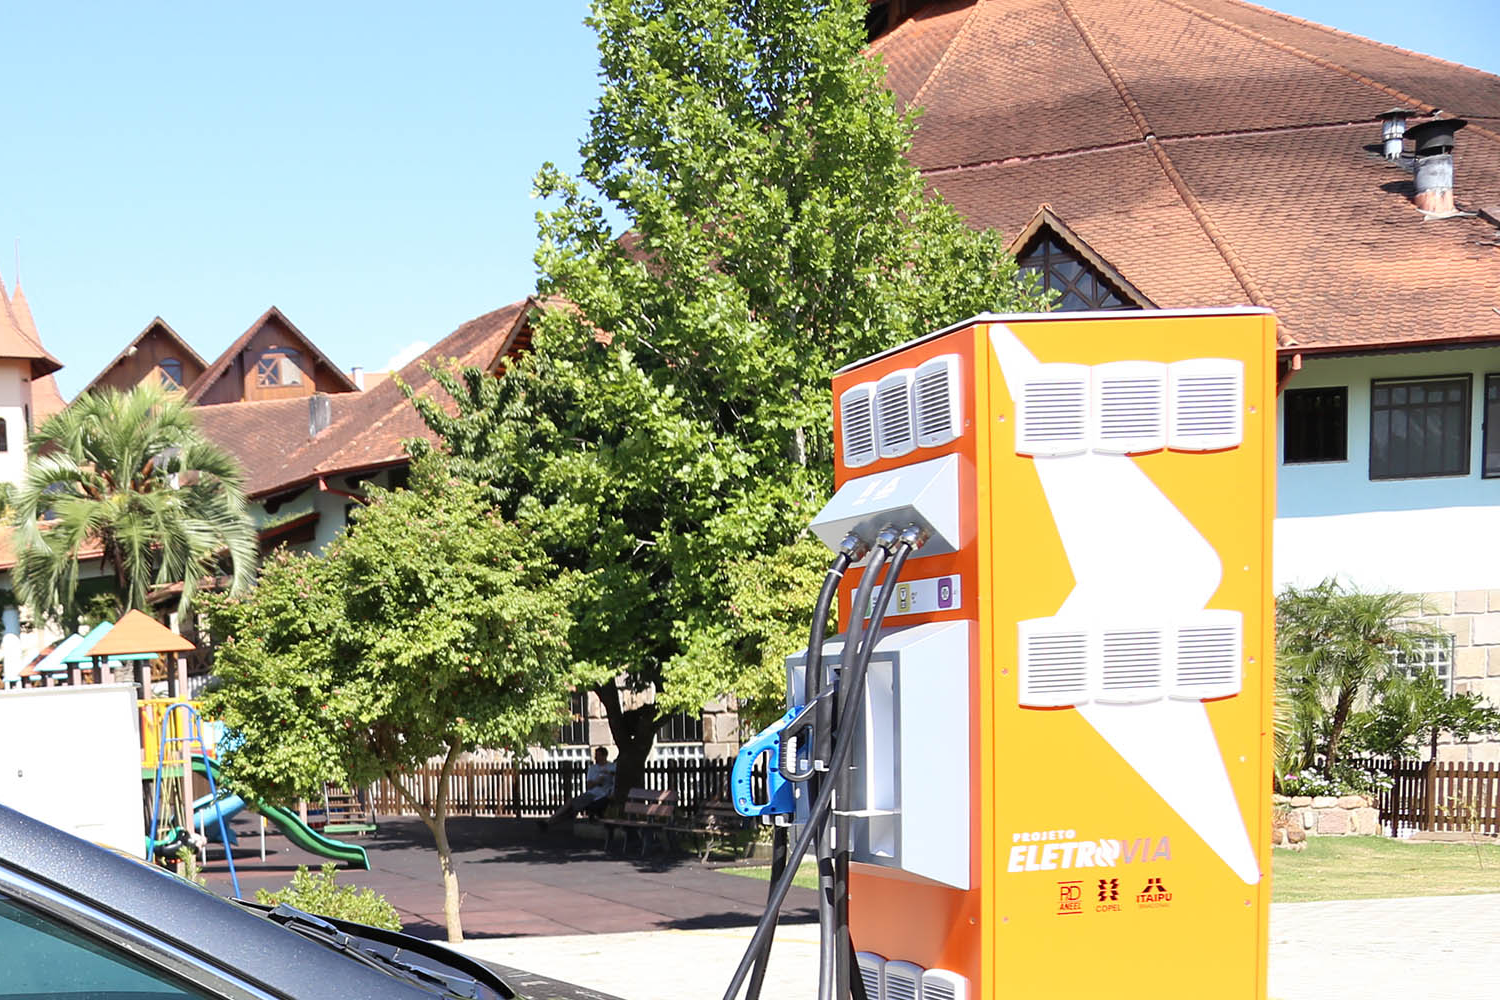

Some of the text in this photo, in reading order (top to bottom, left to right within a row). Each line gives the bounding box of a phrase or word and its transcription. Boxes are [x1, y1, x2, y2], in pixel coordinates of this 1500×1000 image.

[1012, 829, 1076, 843] PROJETO
[1136, 893, 1173, 903] ITAIPU
[1095, 904, 1122, 913] COPEL
